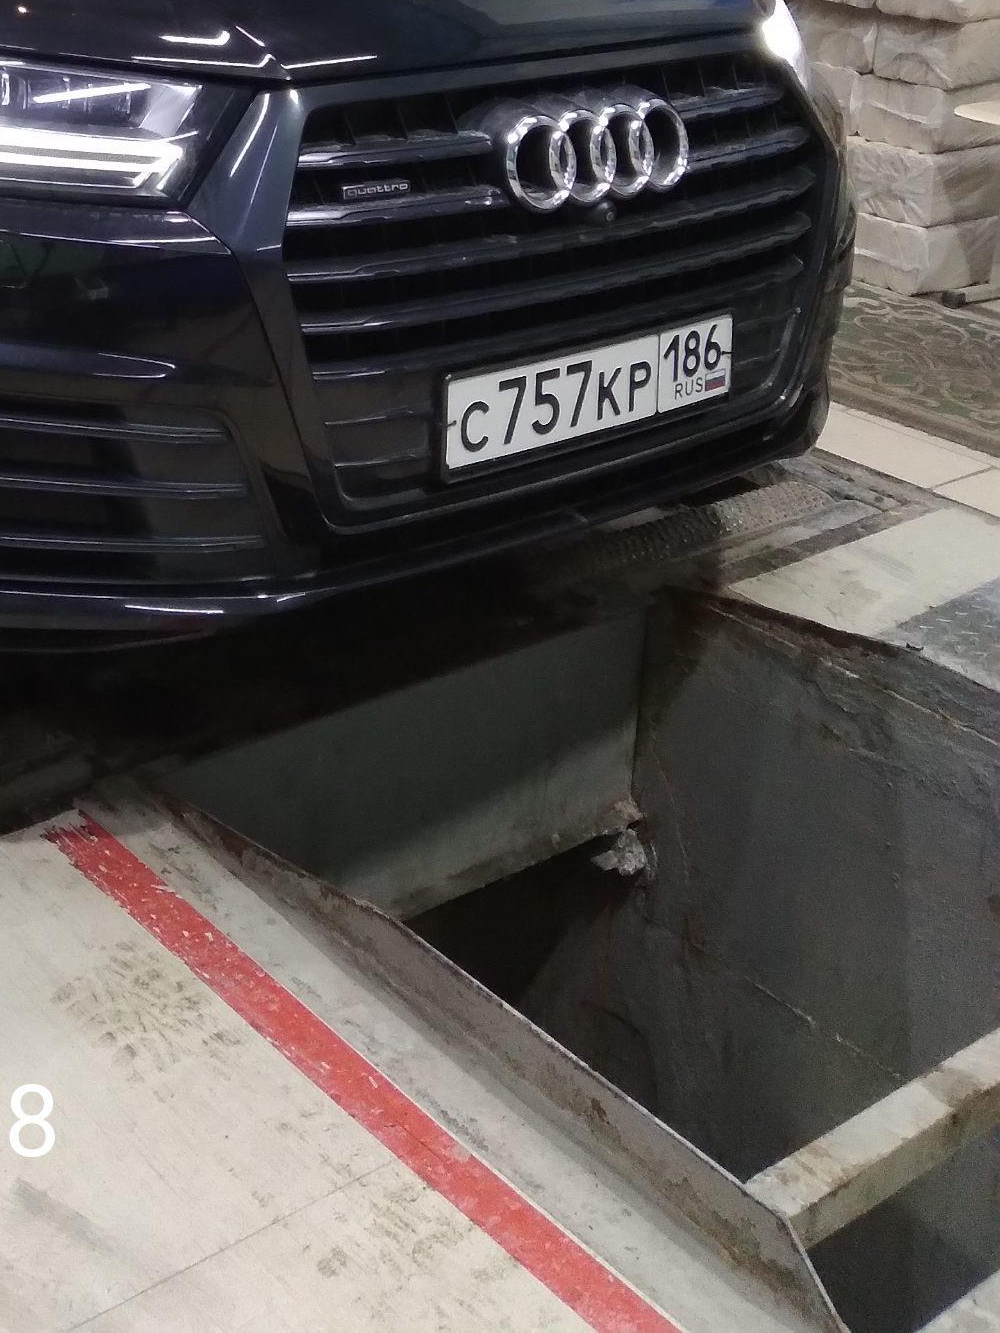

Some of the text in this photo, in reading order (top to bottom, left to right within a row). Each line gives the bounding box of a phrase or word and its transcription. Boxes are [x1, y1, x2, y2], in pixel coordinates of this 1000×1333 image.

[347, 183, 409, 198] quattro
[663, 323, 722, 382] 186
[674, 376, 703, 400] RUS
